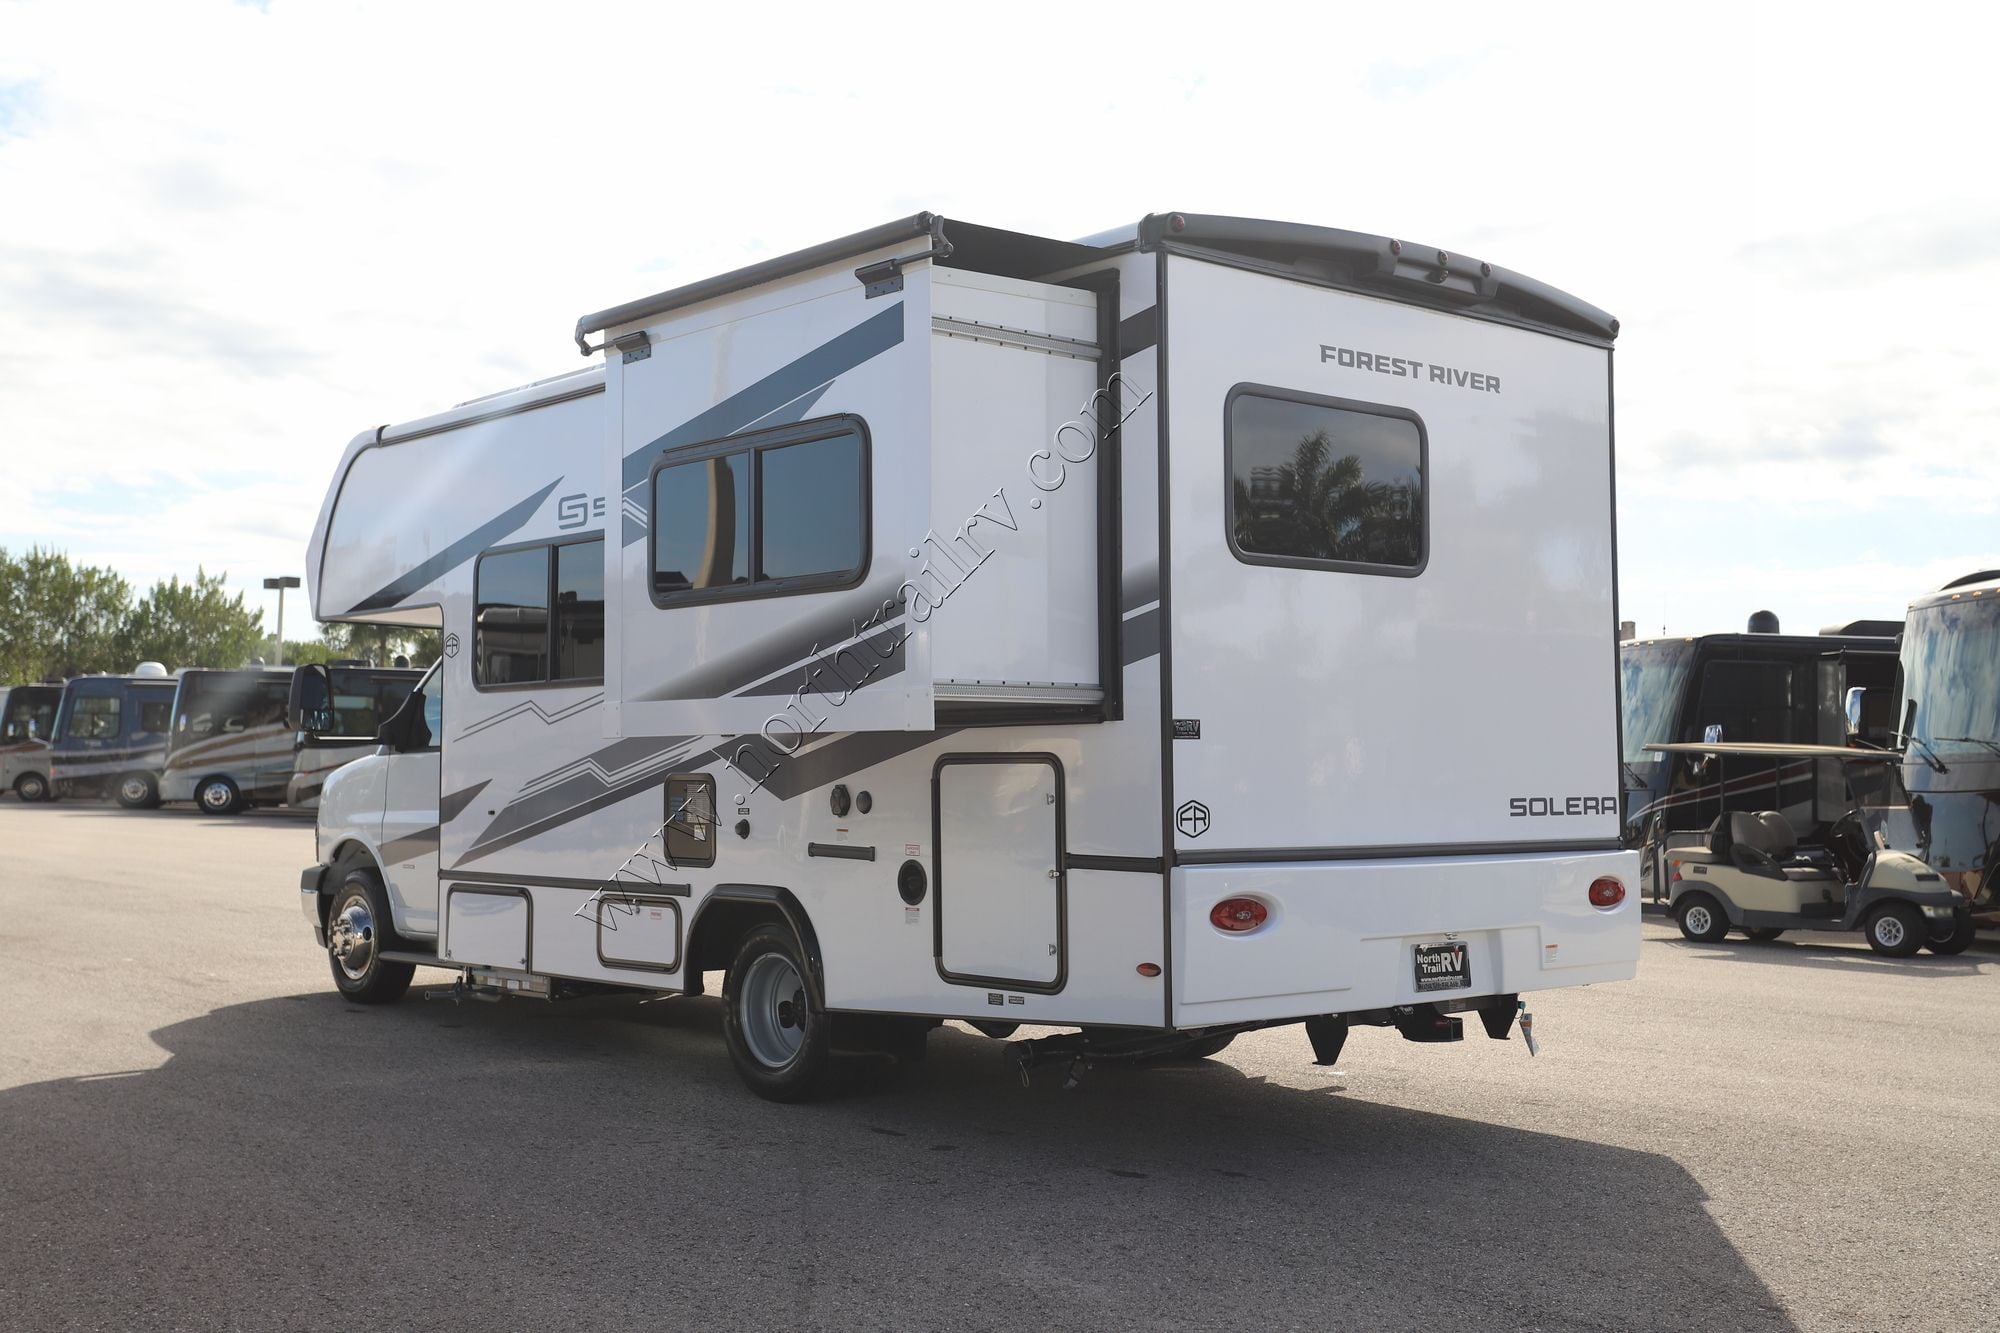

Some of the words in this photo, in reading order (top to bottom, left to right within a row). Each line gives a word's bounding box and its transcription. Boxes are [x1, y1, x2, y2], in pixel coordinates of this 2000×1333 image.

[1319, 344, 1424, 379] FOREST
[1428, 363, 1501, 394] RIVER
[1509, 796, 1618, 817] SOLERA
[1416, 953, 1441, 964] North
[1421, 963, 1442, 974] Trail
[1440, 951, 1463, 973] RV
